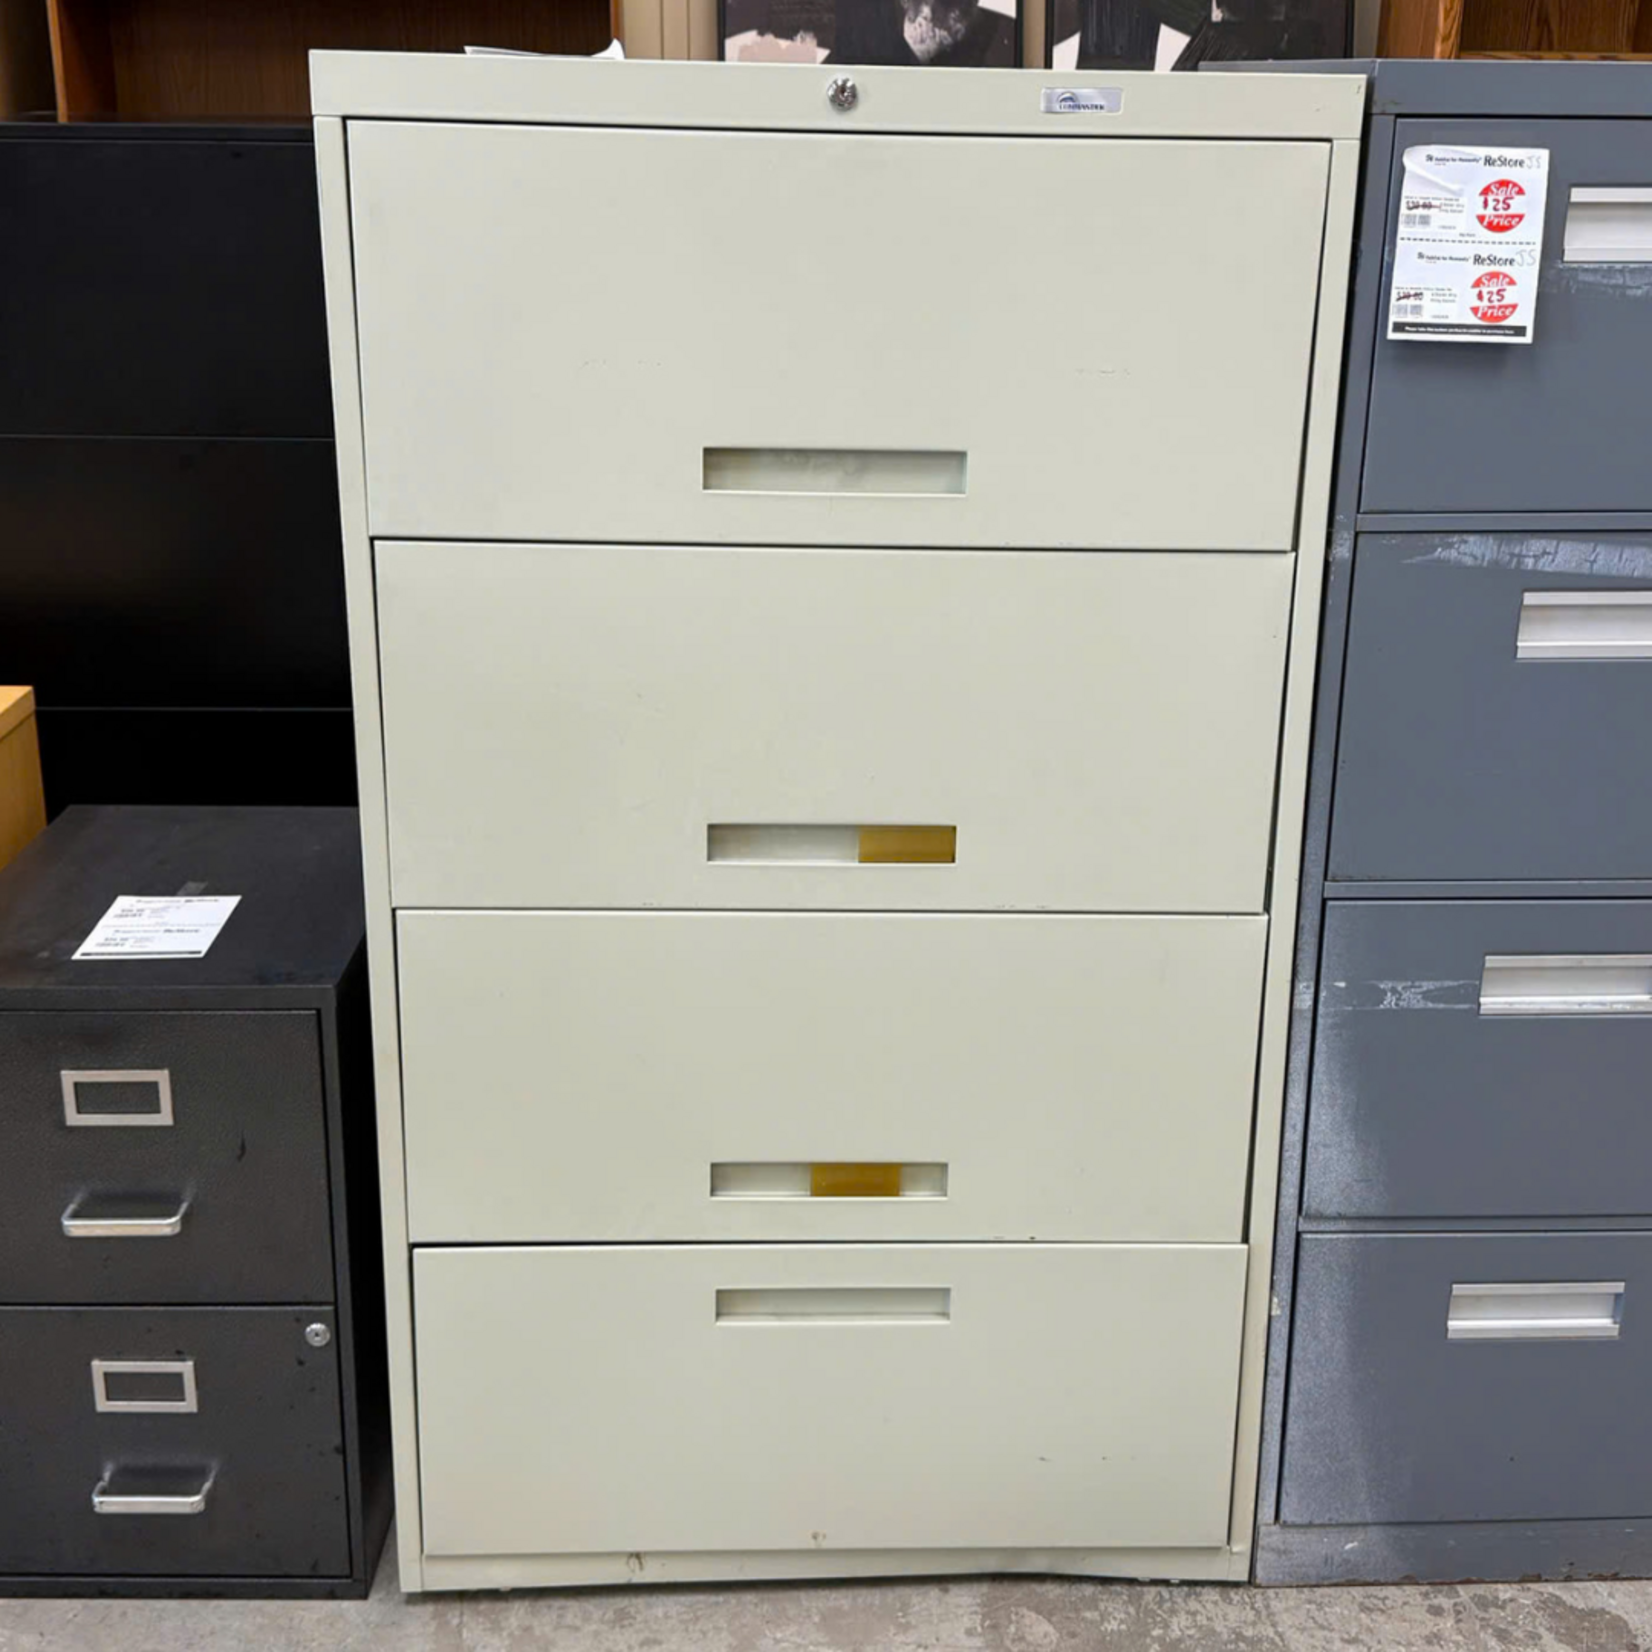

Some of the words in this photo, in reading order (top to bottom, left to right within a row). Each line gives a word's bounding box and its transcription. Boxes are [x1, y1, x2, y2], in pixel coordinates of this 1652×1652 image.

[1483, 155, 1525, 168] ReStore
[1488, 184, 1519, 196] Sale
[1483, 214, 1520, 226] Price
[1473, 253, 1516, 266] ReStore
[1480, 275, 1510, 287] Sale
[1477, 305, 1513, 317] Price
